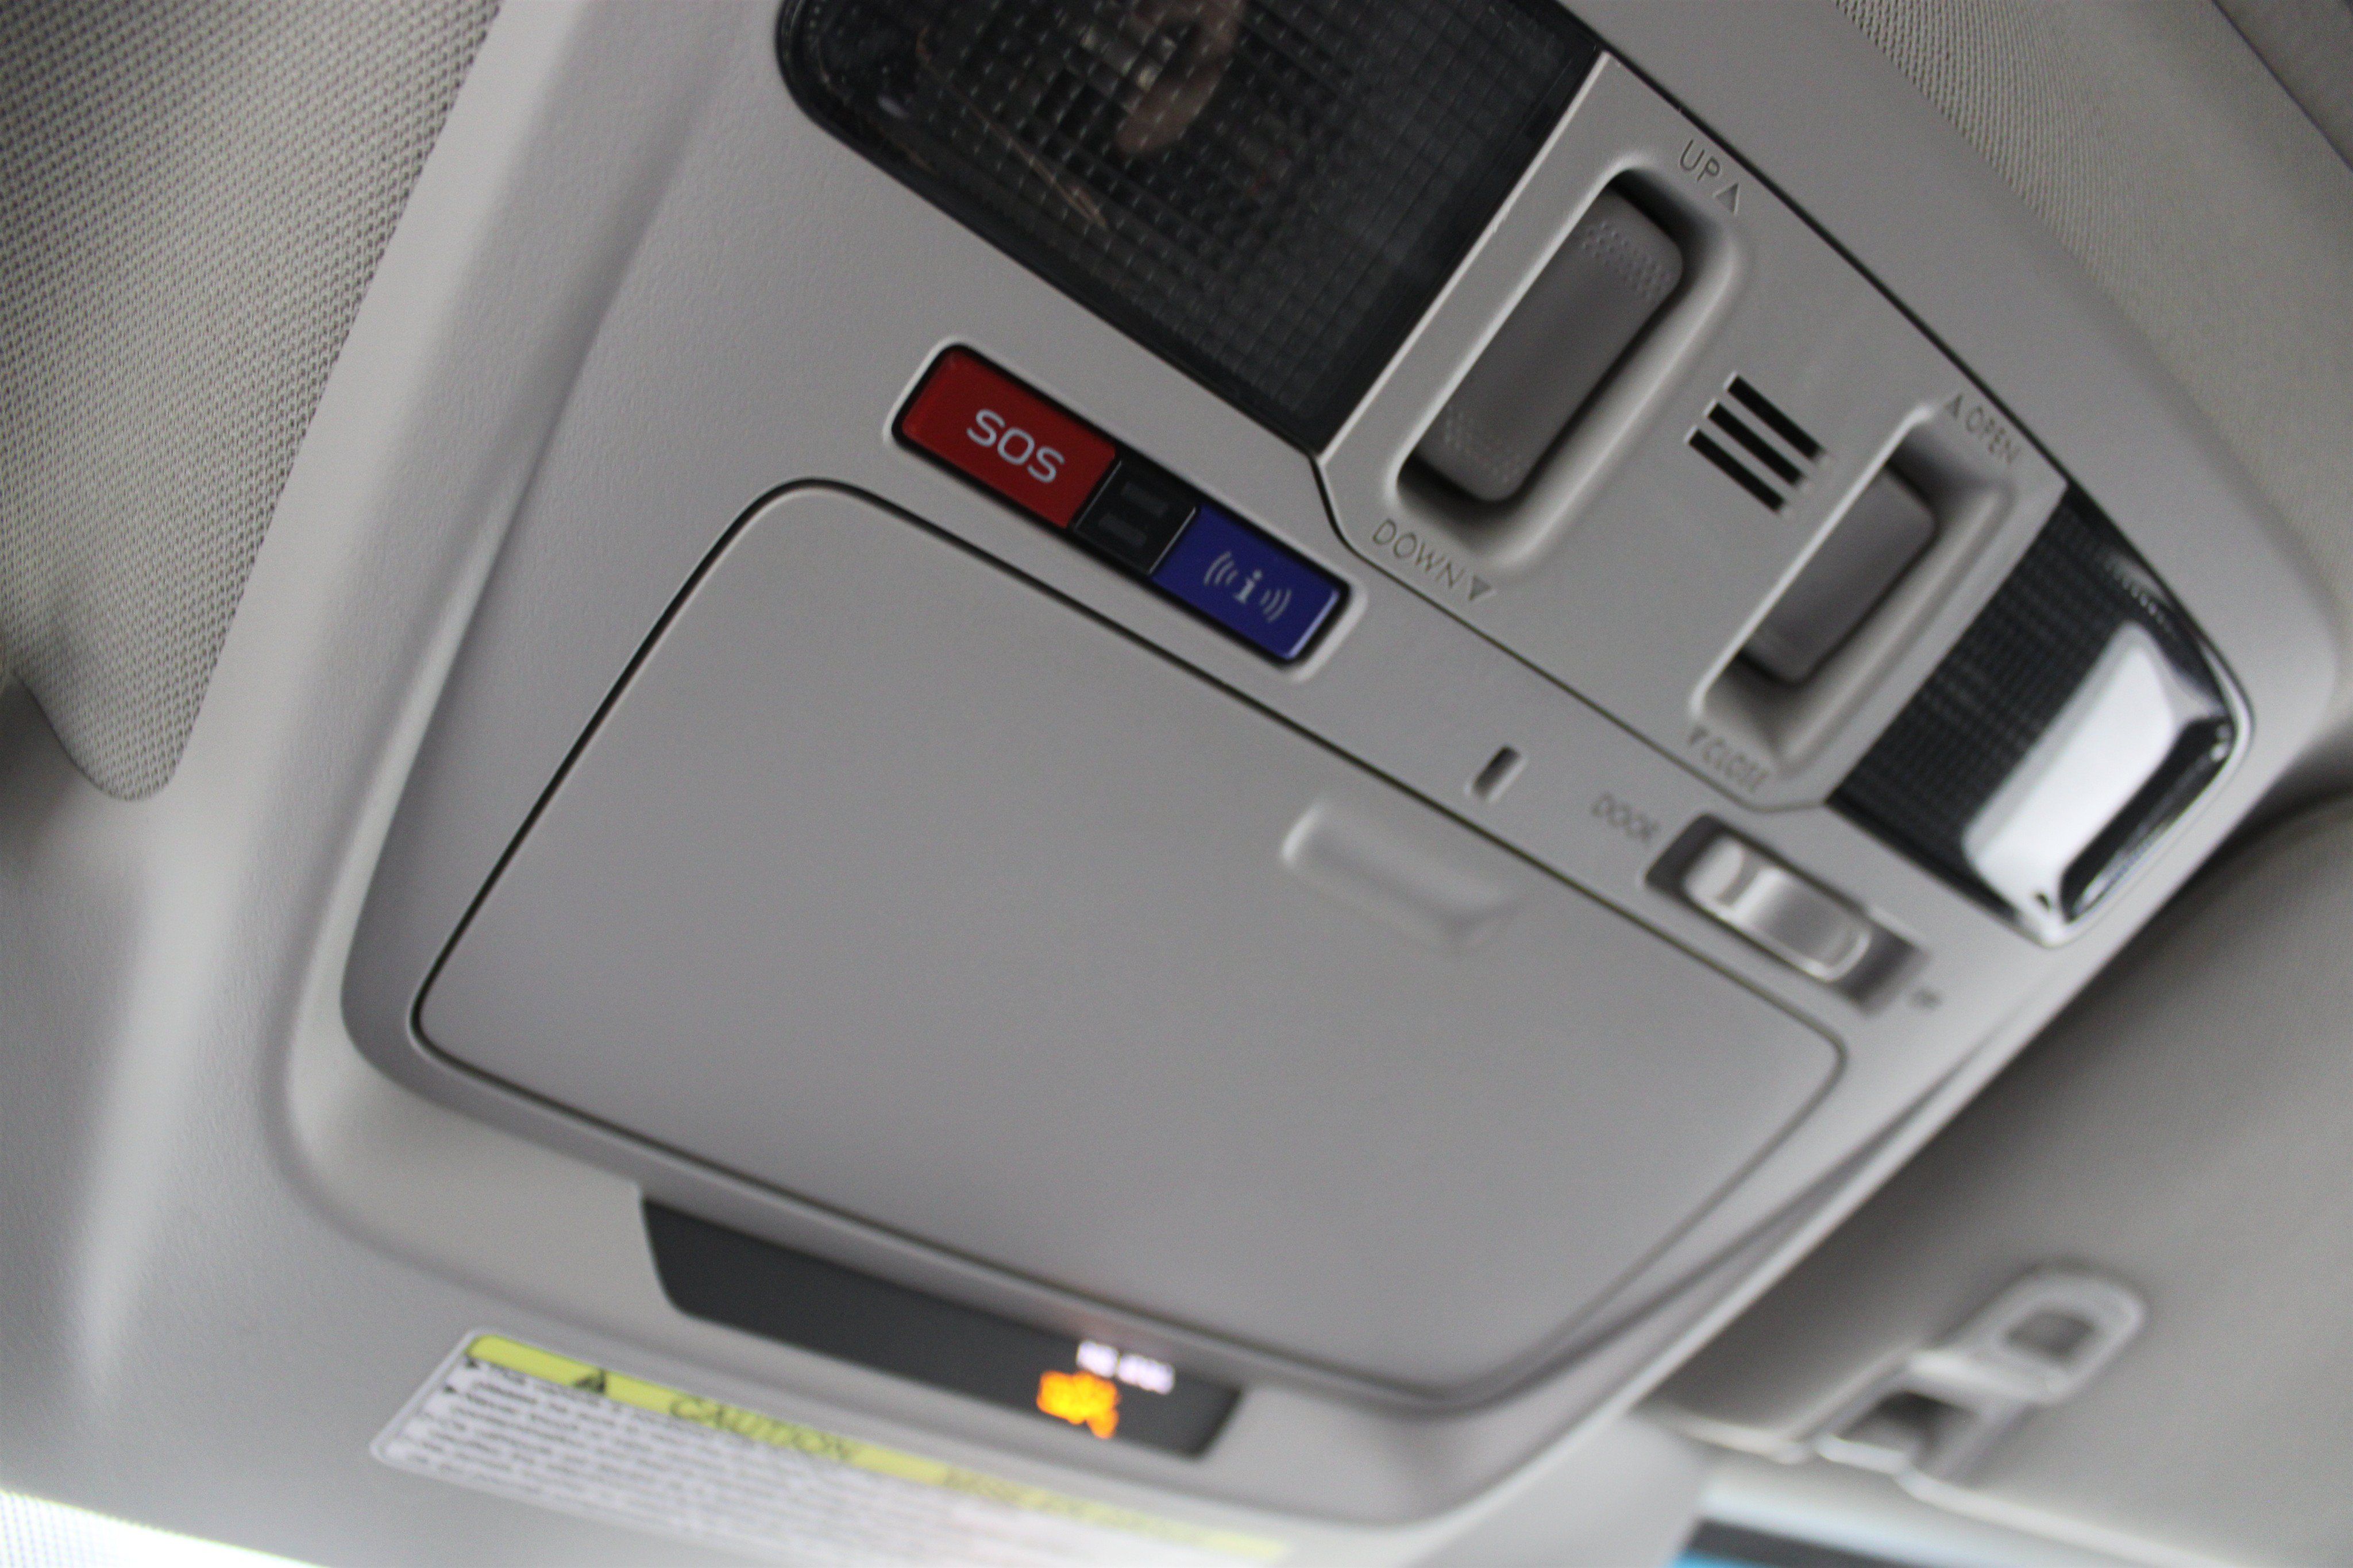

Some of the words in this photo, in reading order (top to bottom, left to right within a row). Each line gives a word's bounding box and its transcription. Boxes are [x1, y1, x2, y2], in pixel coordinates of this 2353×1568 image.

[1680, 139, 1721, 182] UP
[966, 409, 1066, 484] SOS
[1372, 517, 1466, 589] DOWN
